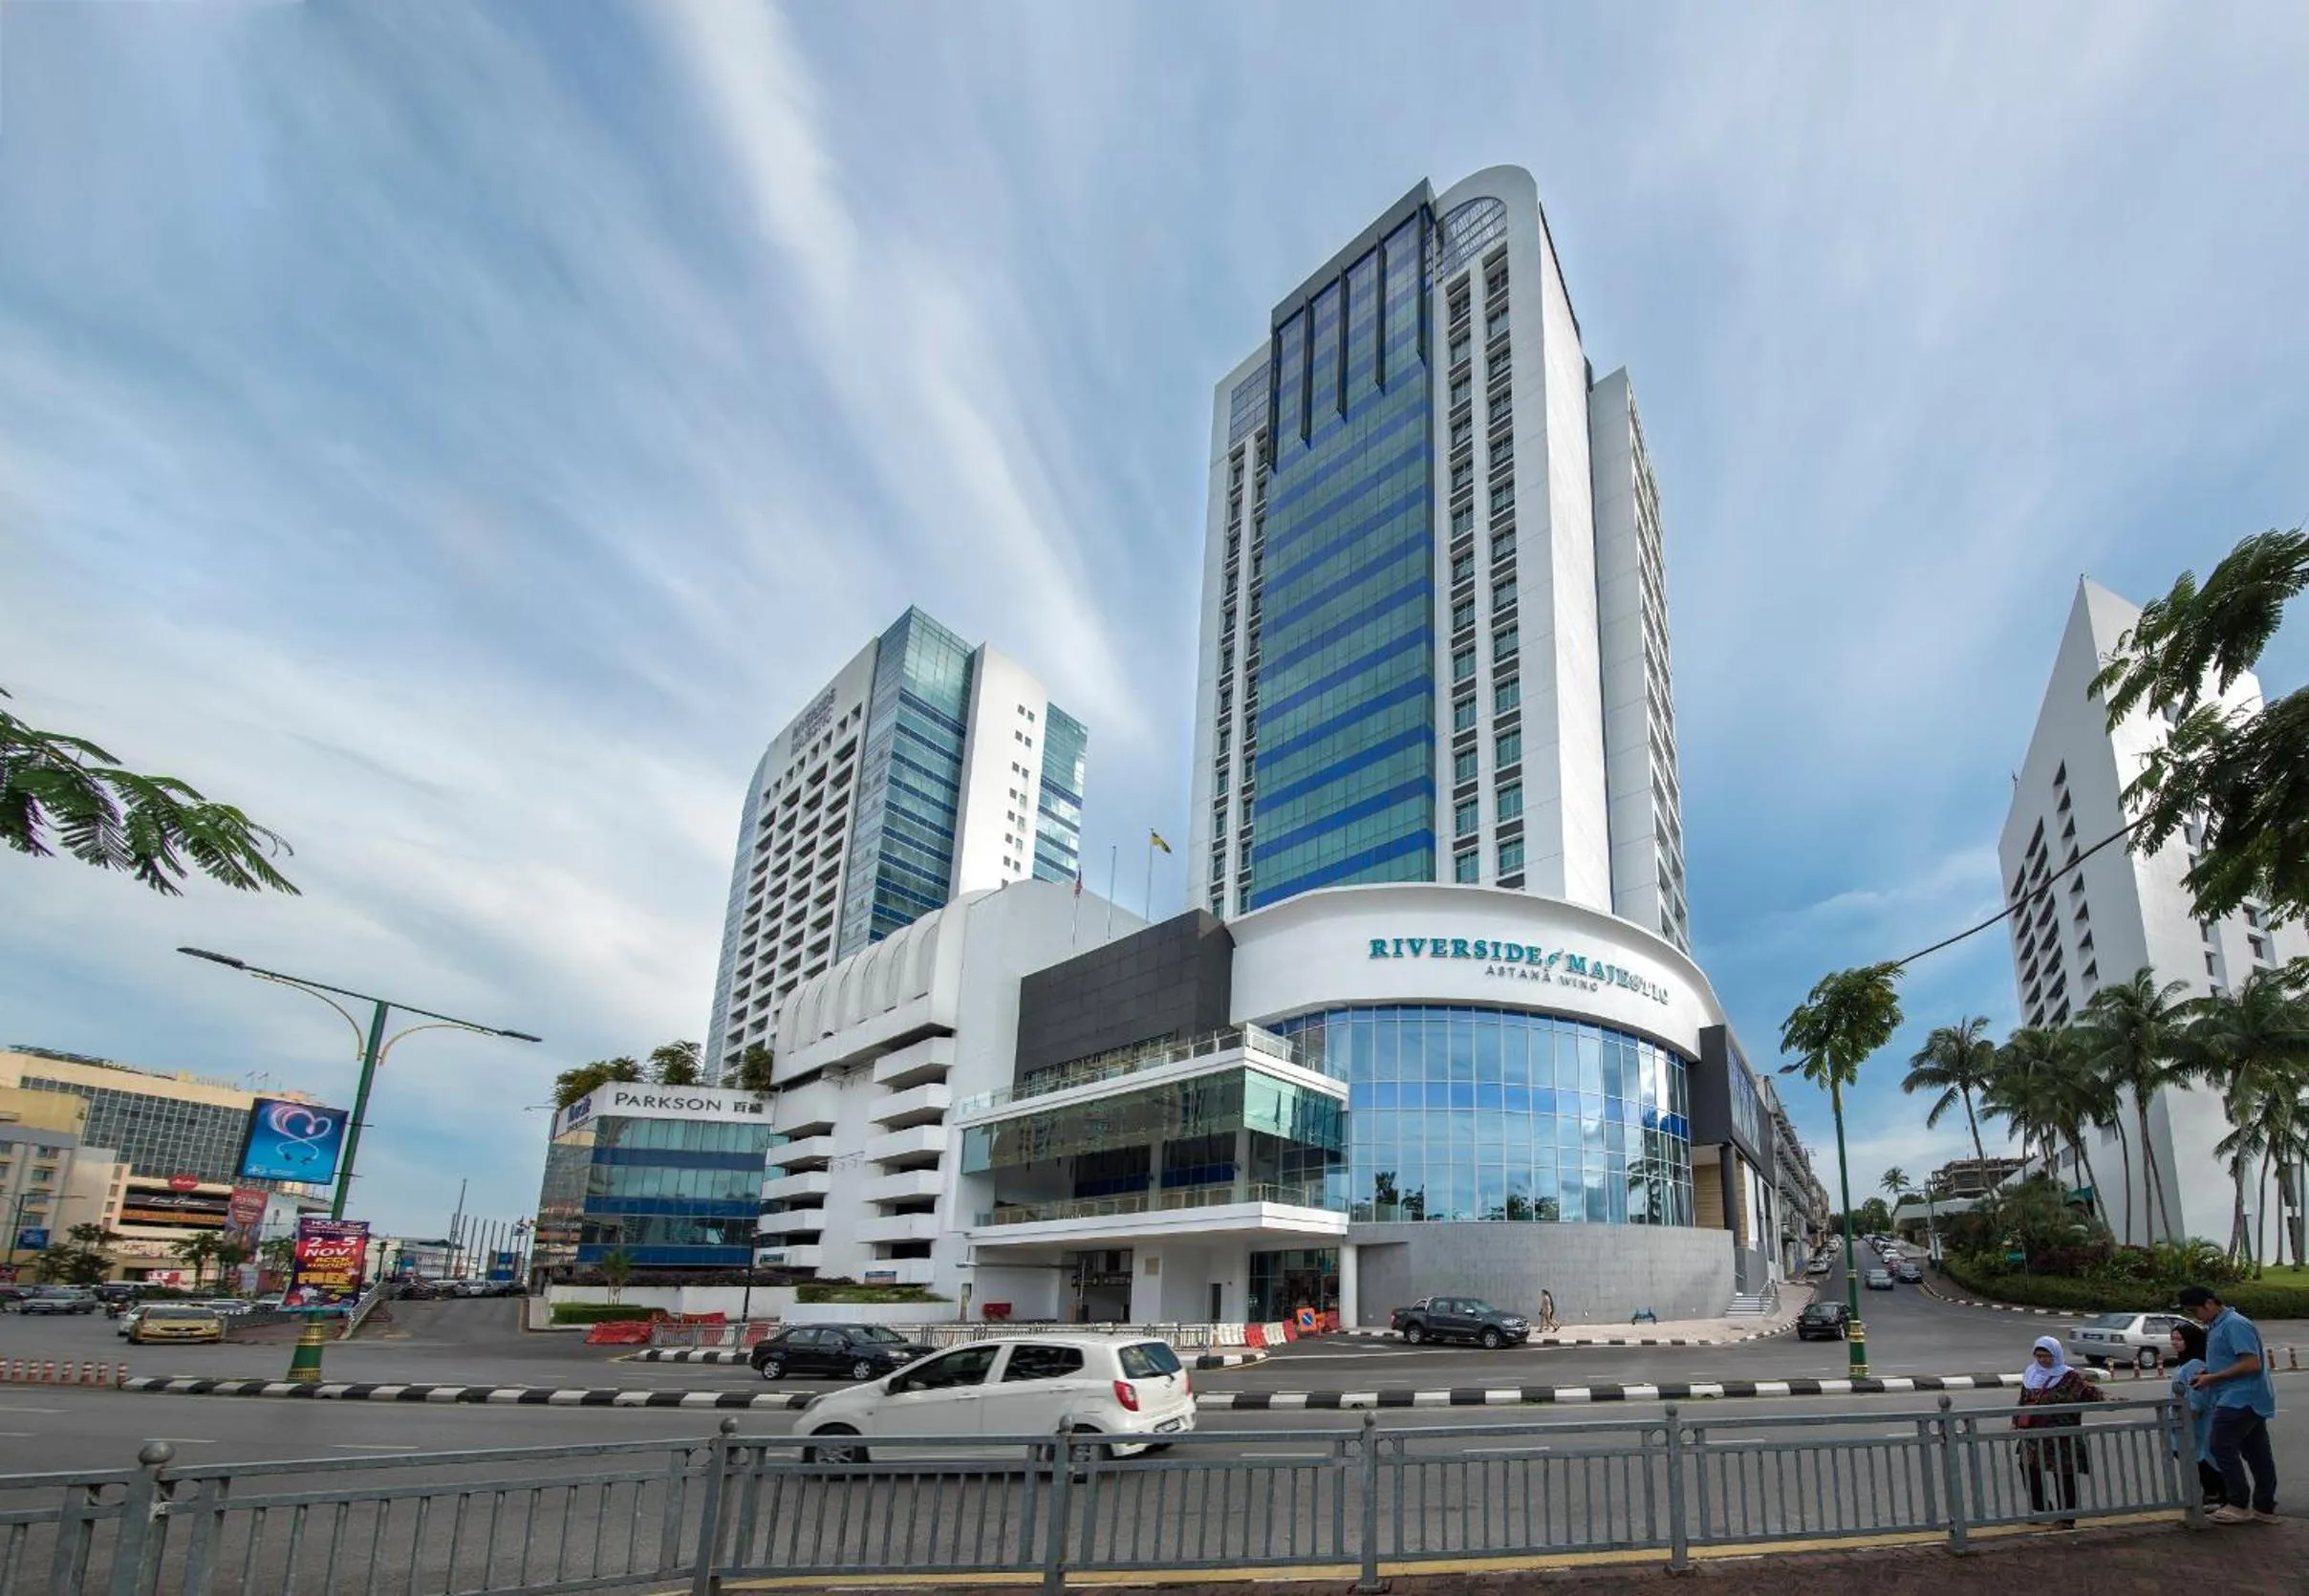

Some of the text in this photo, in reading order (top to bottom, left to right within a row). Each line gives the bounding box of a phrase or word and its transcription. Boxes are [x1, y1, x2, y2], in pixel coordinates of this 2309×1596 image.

[1369, 938, 1543, 966] RIVERSIDE
[1485, 965, 1599, 992] ASTANA WING
[615, 1092, 722, 1111] PARKSON
[308, 1237, 324, 1247] 2
[341, 1237, 357, 1246] 5
